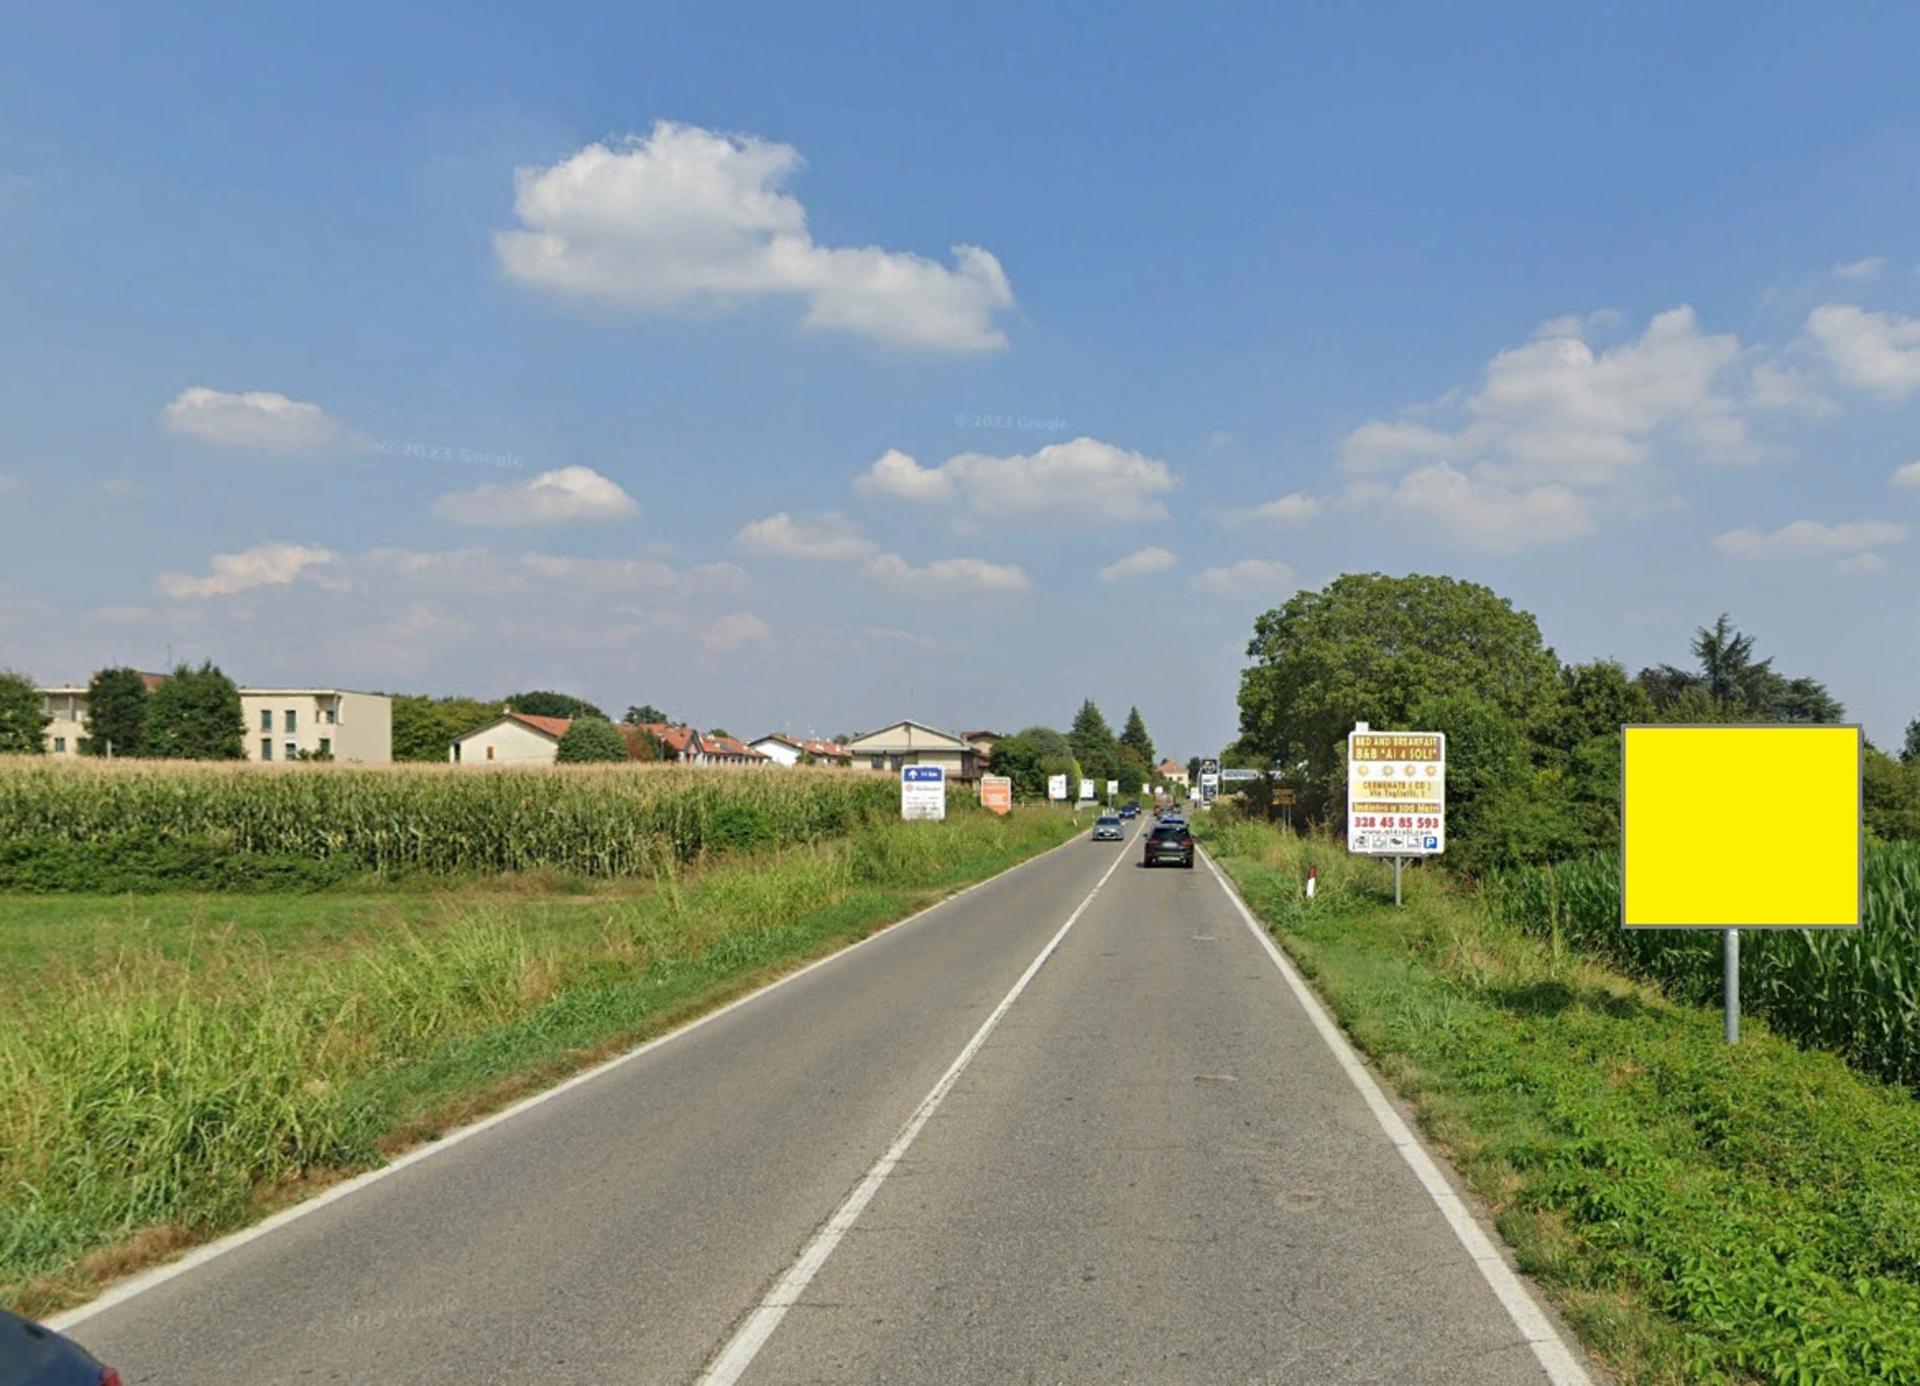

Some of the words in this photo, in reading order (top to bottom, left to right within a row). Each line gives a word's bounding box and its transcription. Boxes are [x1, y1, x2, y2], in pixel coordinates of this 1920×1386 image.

[1355, 737, 1371, 747] BED
[1373, 737, 1391, 747] AND
[1355, 748, 1377, 759] B&B
[1354, 817, 1376, 828] 328
[1380, 817, 1395, 828] 45
[1398, 817, 1413, 828] 85
[1416, 817, 1439, 829] 593
